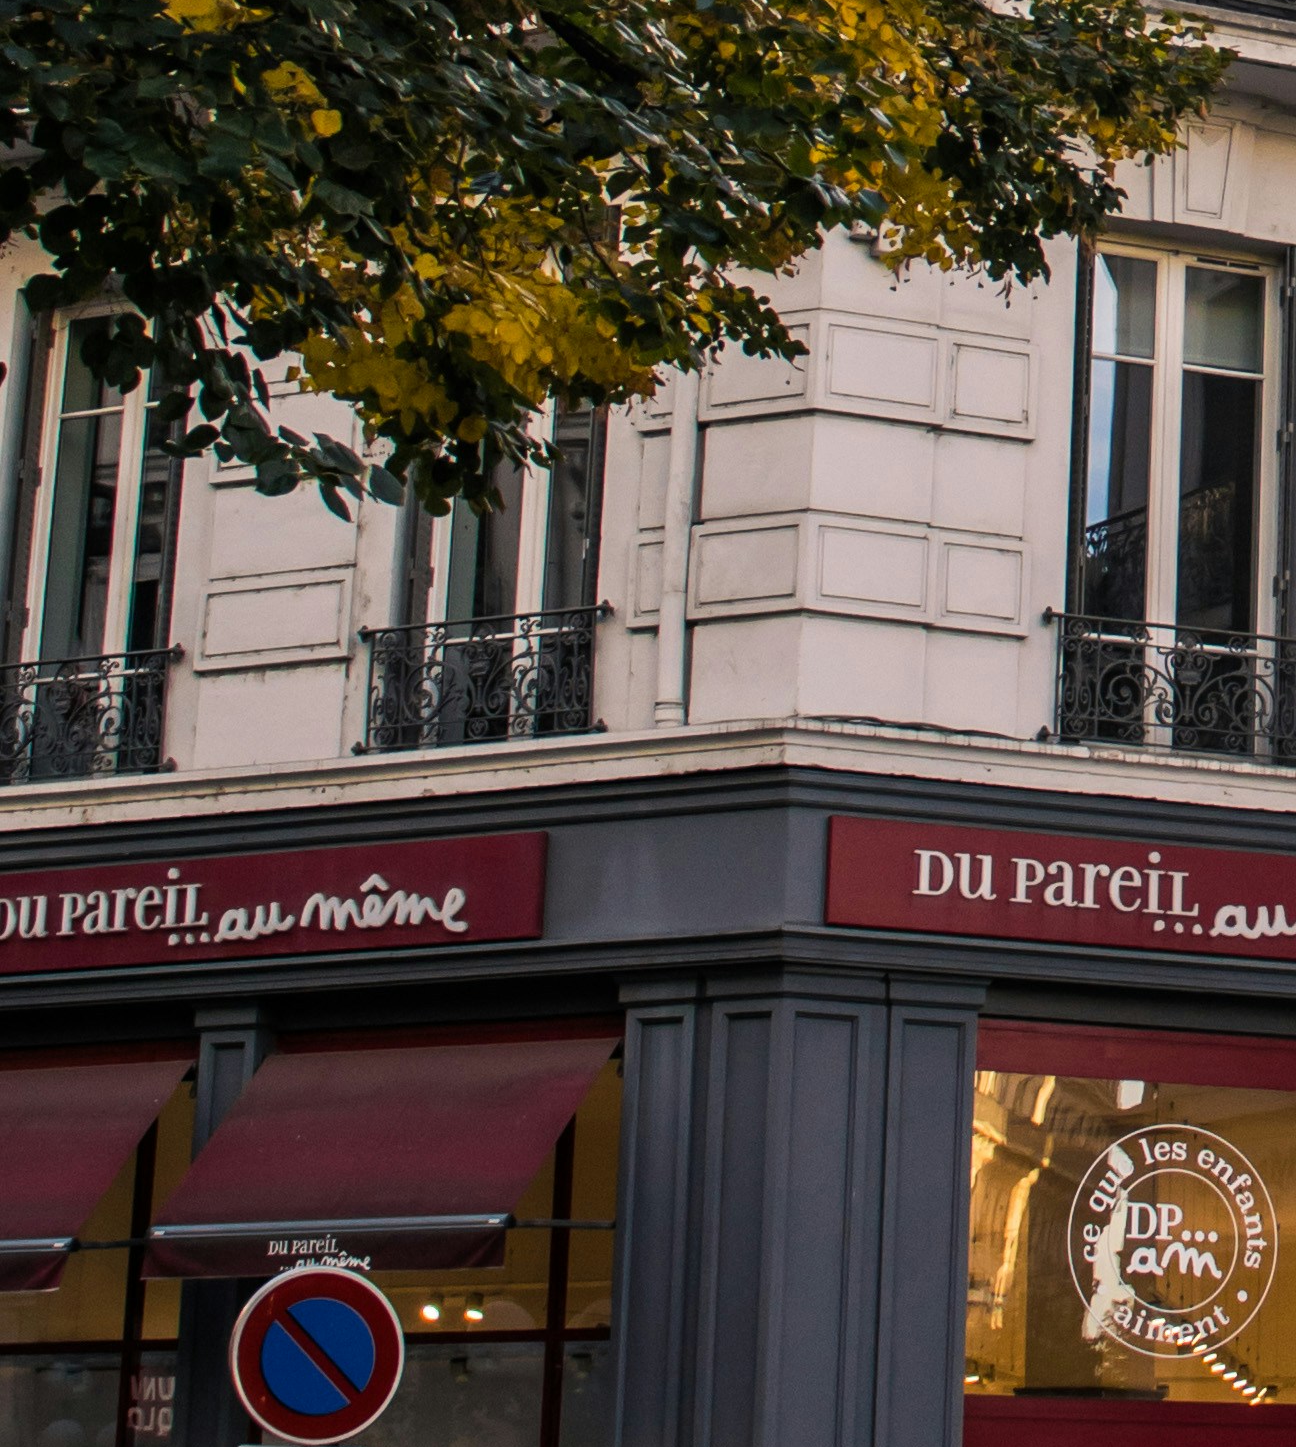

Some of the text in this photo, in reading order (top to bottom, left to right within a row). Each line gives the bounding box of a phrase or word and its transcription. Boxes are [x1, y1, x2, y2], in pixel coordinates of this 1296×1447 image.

[300, 874, 468, 933] même
[1138, 1138, 1187, 1165] les
[1197, 1148, 1267, 1269] enfants
[1126, 1242, 1222, 1279] am
